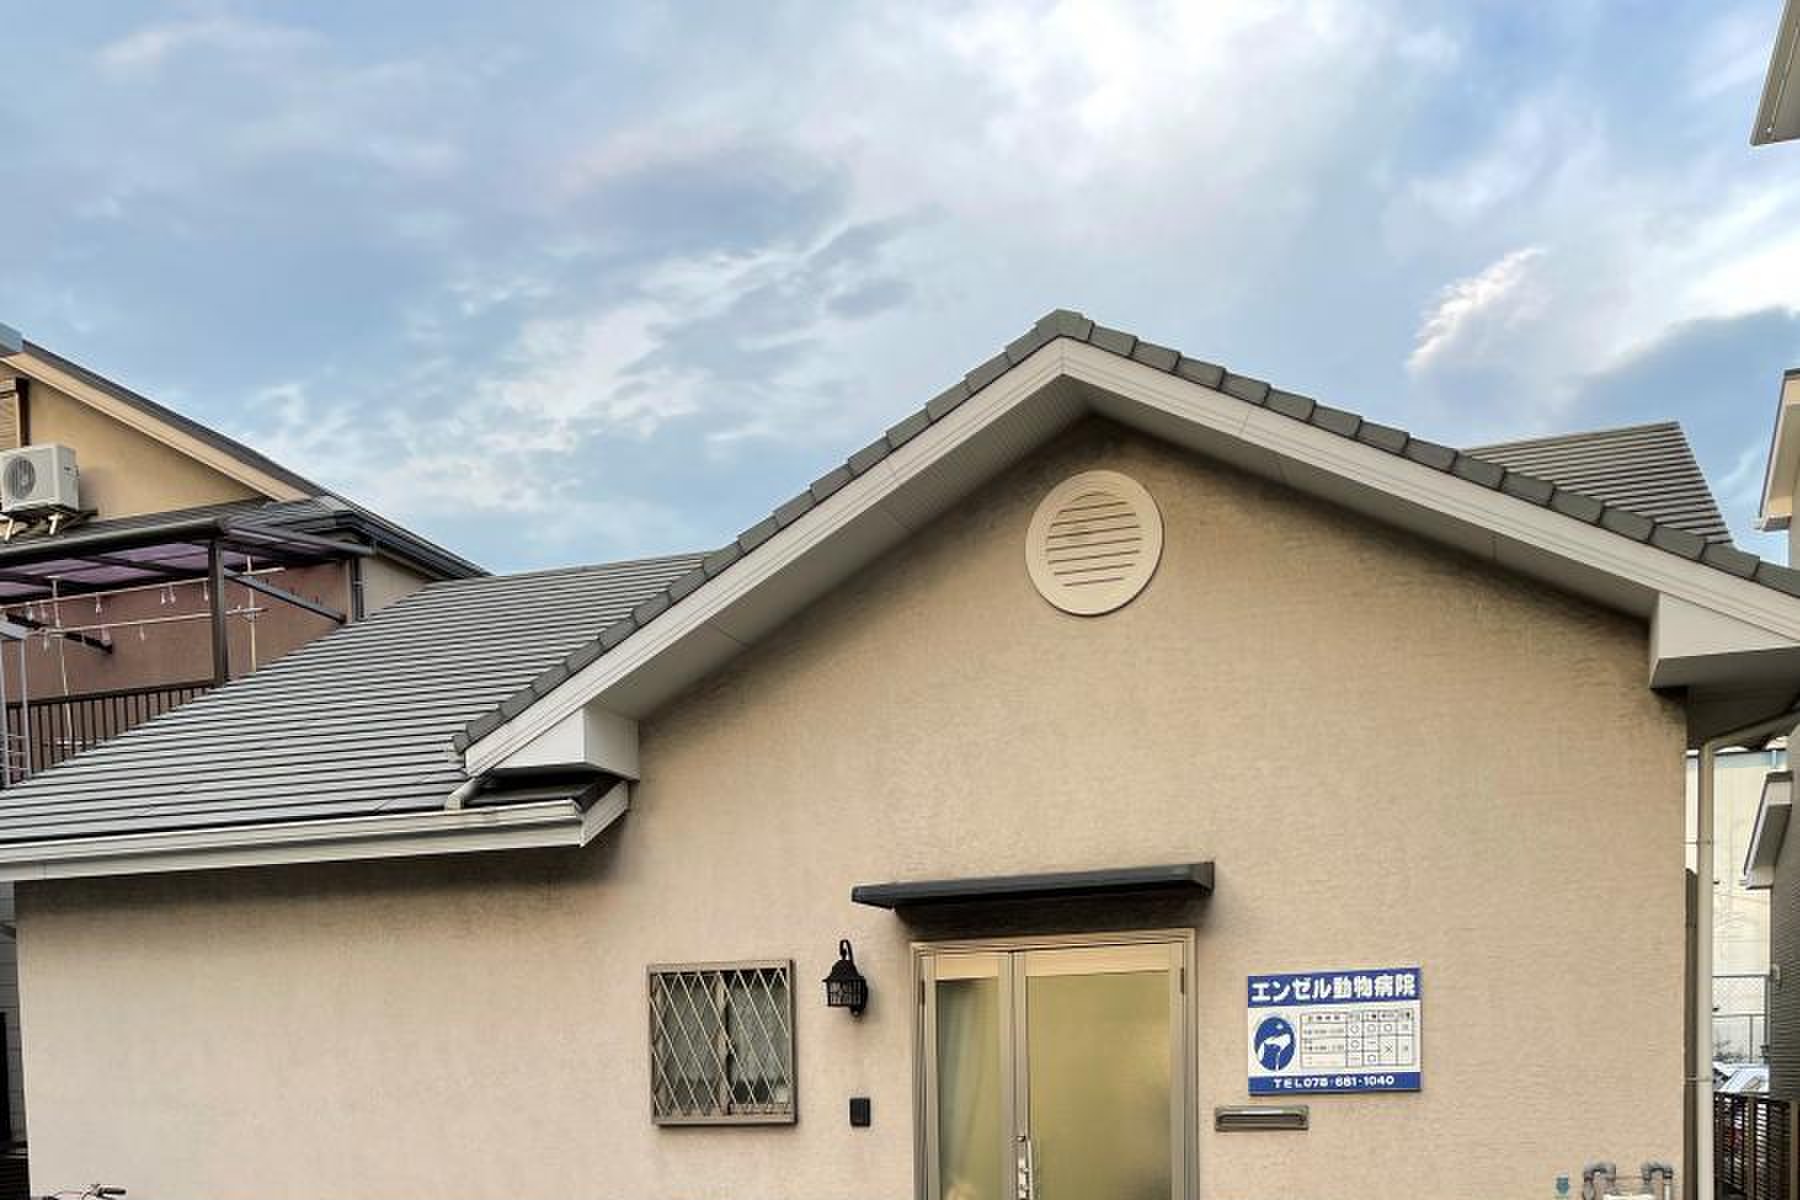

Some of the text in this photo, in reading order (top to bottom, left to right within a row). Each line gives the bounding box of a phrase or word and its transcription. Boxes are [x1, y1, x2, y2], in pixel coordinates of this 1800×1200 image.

[1251, 974, 1415, 1002] エンゼル動物病院
